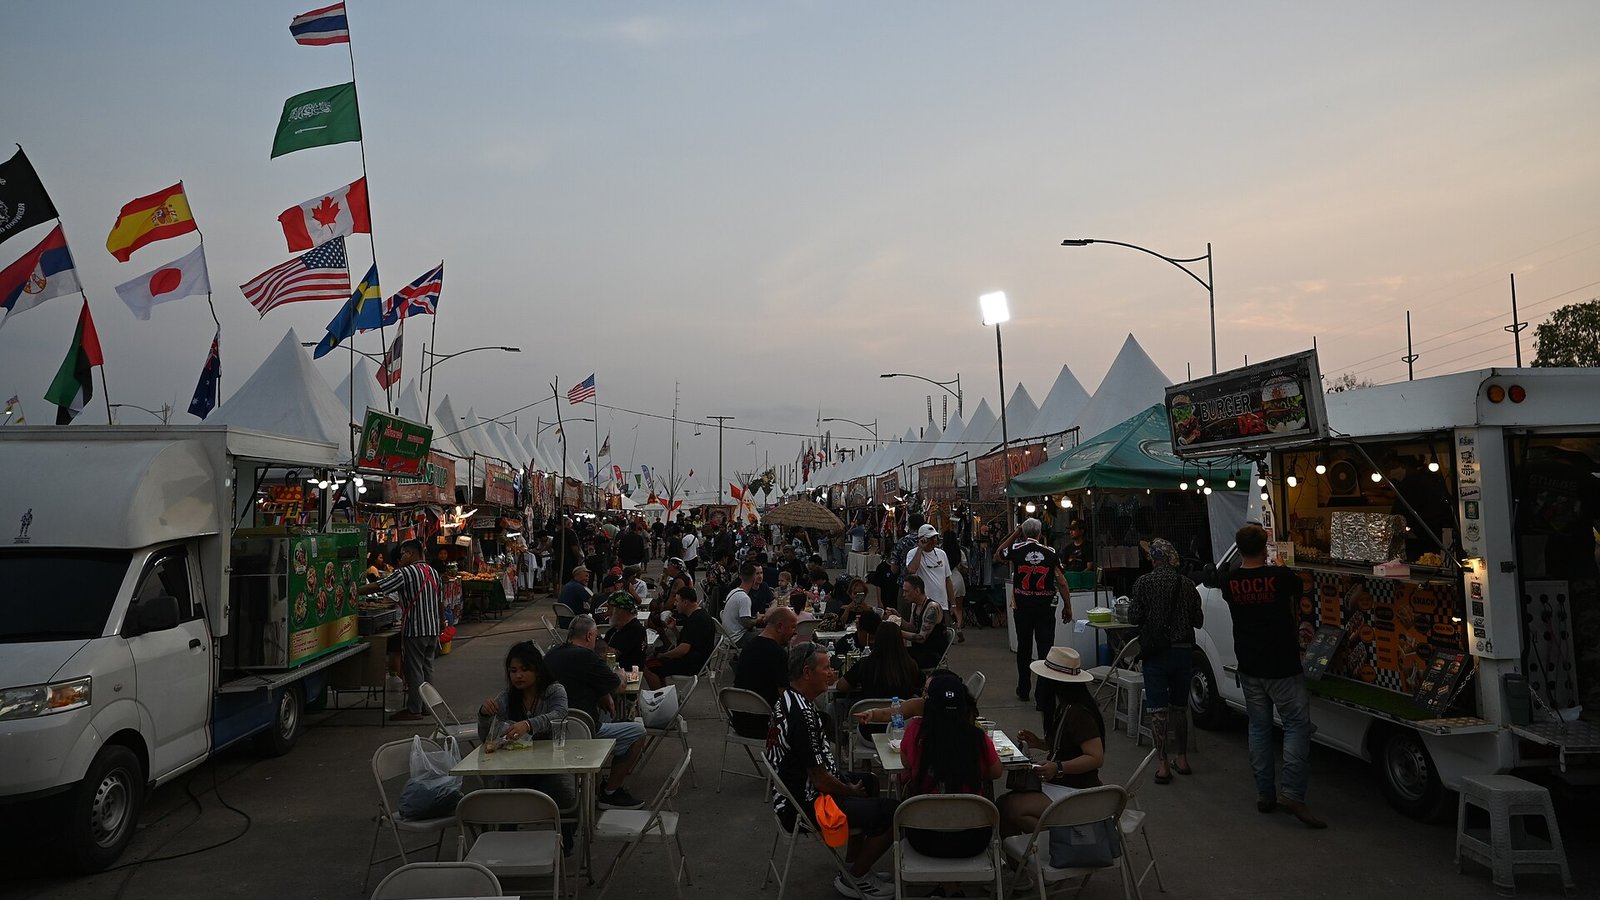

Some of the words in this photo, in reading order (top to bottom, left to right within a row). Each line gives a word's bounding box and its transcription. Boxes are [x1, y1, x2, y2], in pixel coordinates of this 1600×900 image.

[1201, 394, 1252, 422] BURGER
[1017, 564, 1050, 591] 77
[1229, 576, 1277, 595] ROCK
[1412, 596, 1436, 606] SHACK
